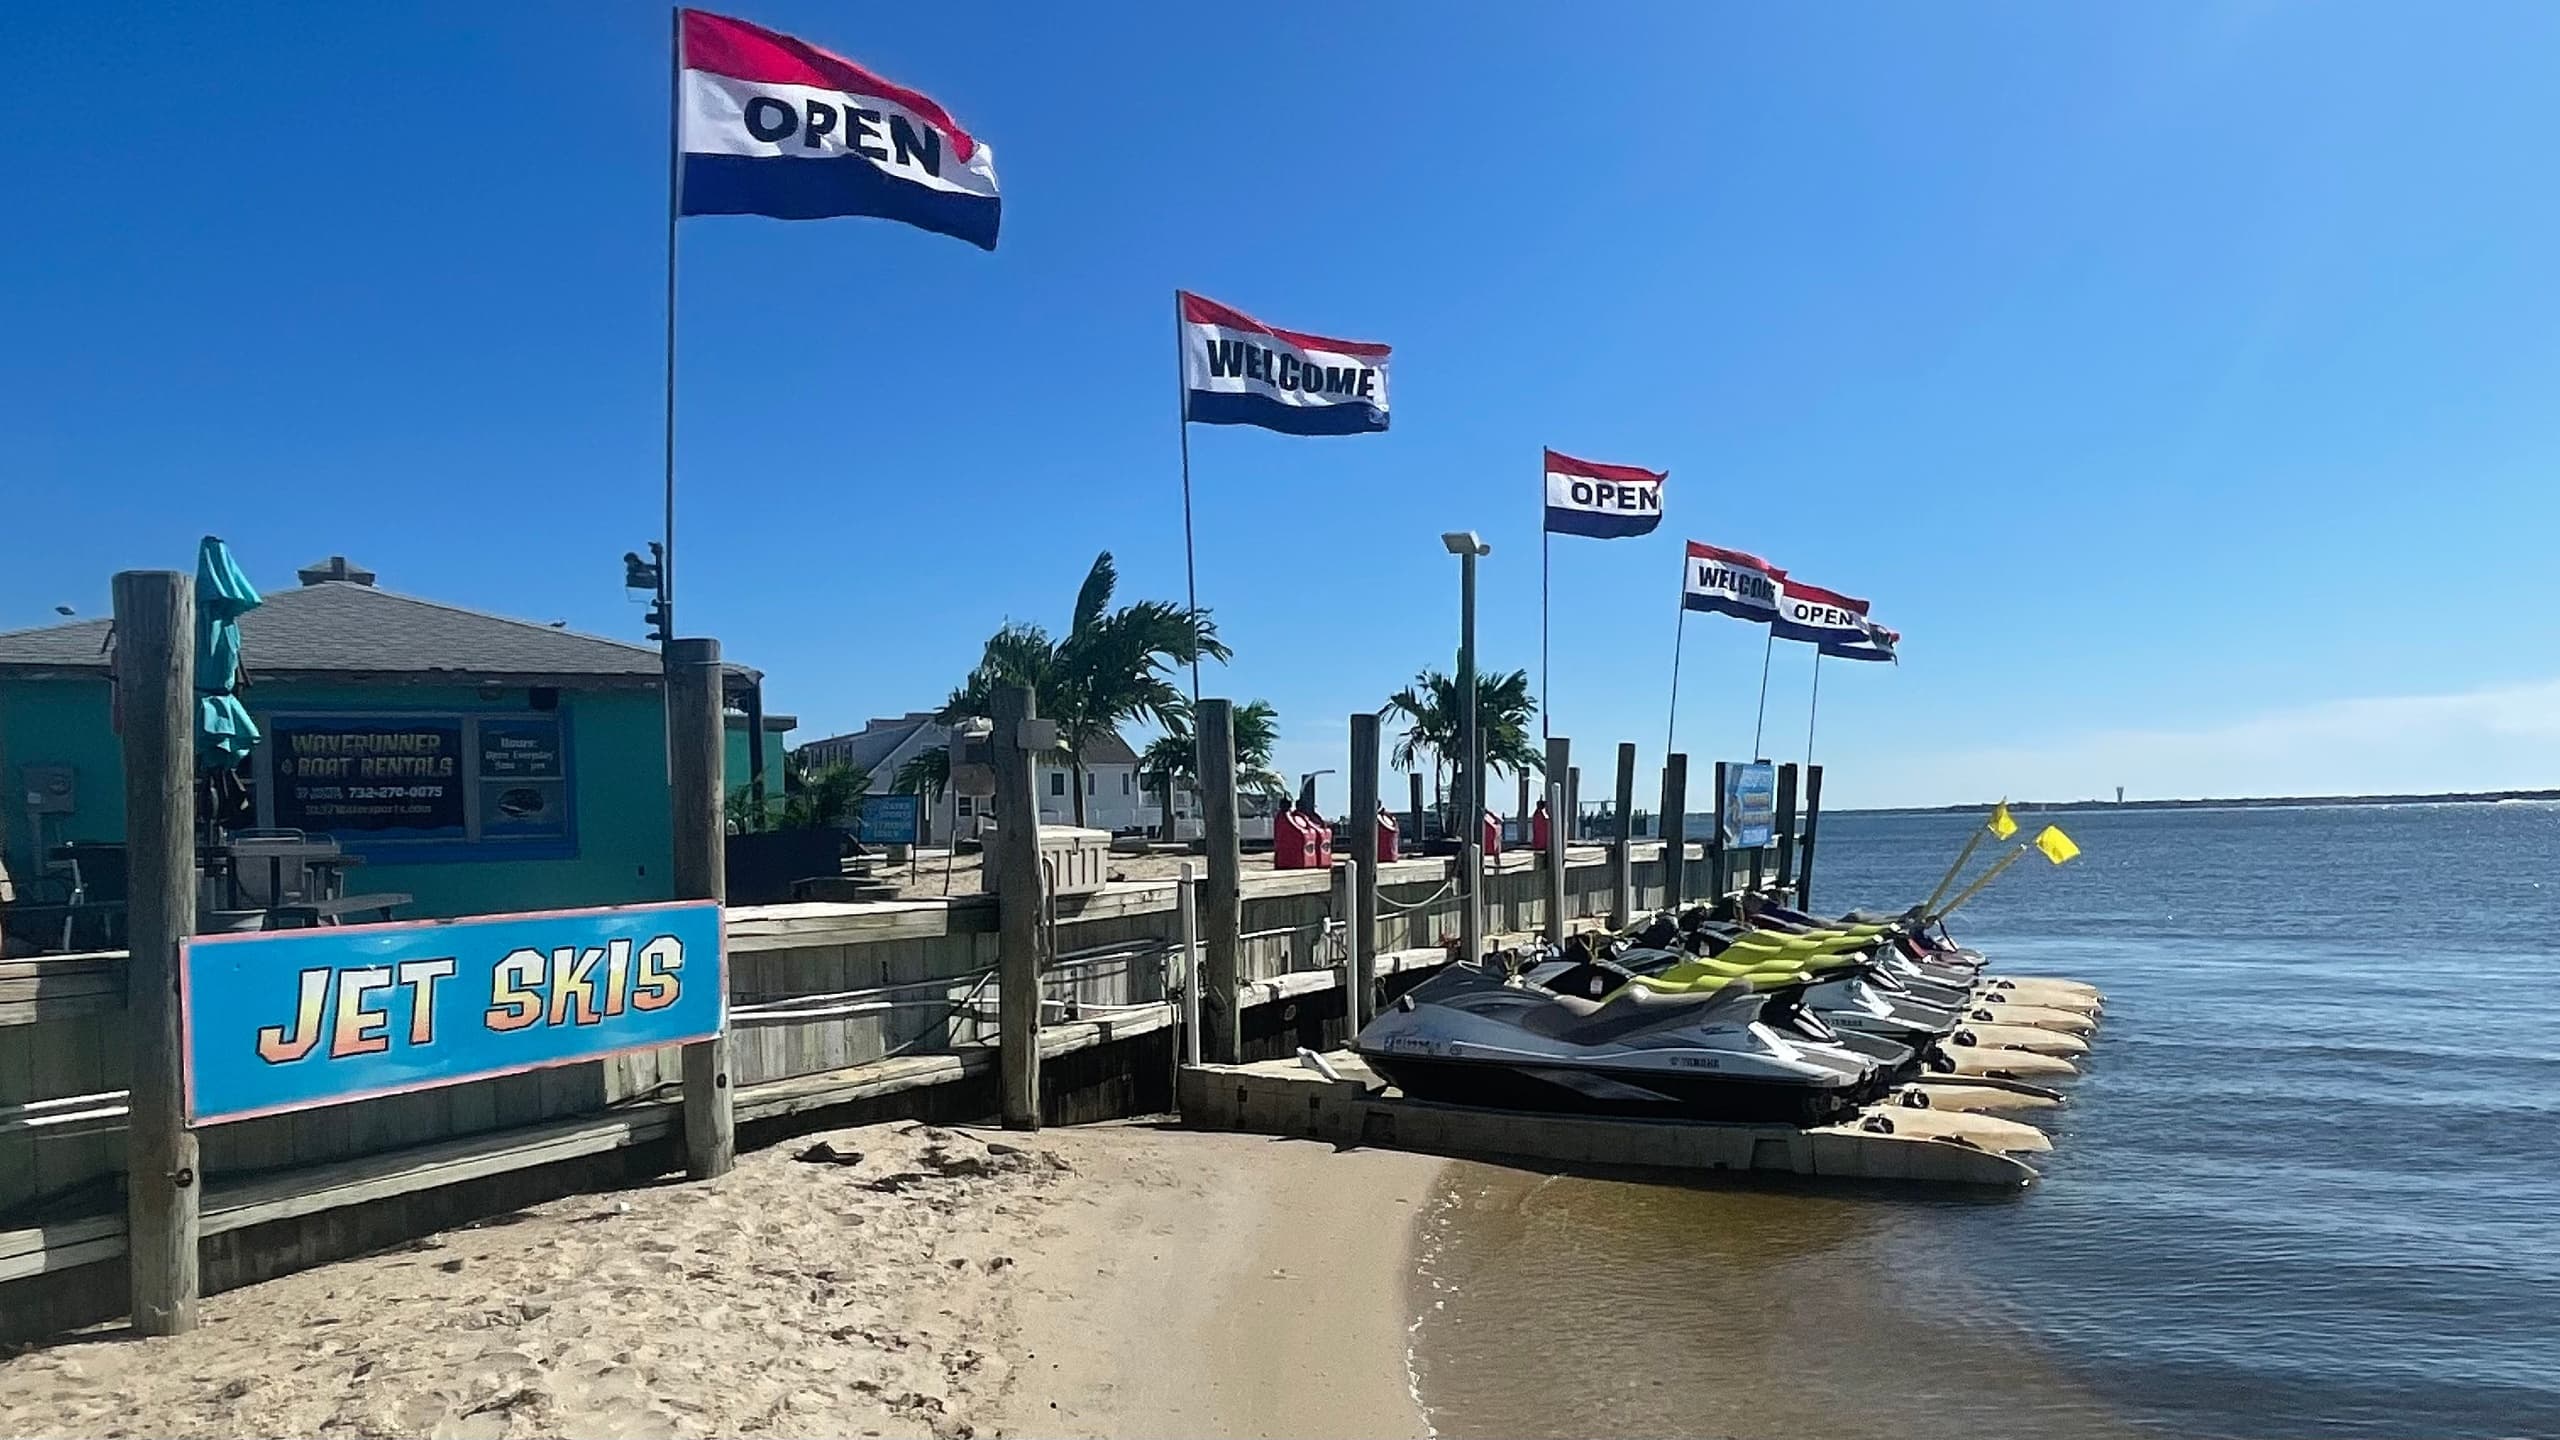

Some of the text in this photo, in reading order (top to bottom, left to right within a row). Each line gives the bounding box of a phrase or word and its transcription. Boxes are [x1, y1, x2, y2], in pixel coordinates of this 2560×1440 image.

[743, 95, 942, 178] OPEN
[1206, 339, 1375, 400] WELCOME
[1570, 481, 1660, 511] OPEN
[1793, 603, 1854, 627] OPEN
[291, 733, 442, 753] WAVERUNNER
[297, 757, 353, 778] BOAT
[360, 756, 454, 777] RENTALS
[256, 934, 684, 1066] JET SKIS
